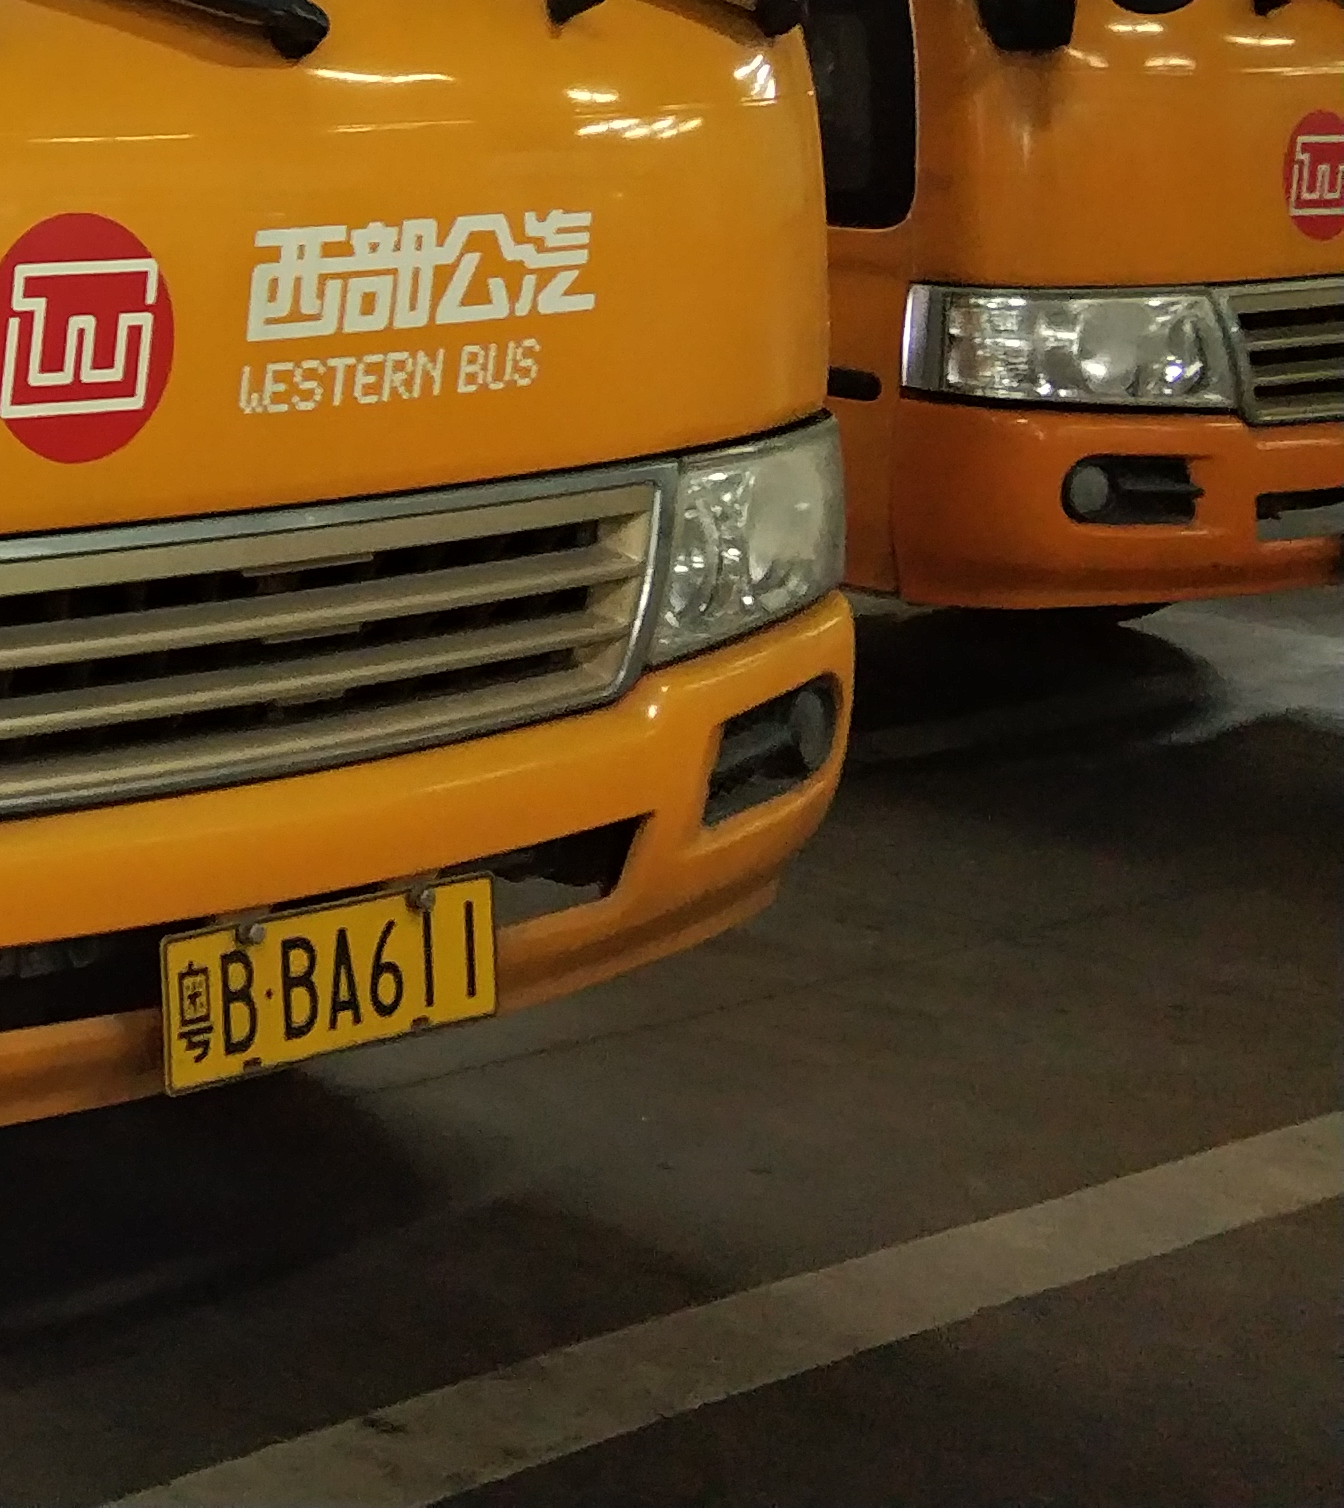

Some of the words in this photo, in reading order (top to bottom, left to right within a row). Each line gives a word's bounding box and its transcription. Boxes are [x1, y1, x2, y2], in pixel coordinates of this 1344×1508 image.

[246, 208, 596, 343] 西部公汽
[238, 348, 445, 415] WESTERN
[456, 338, 542, 393] BUS
